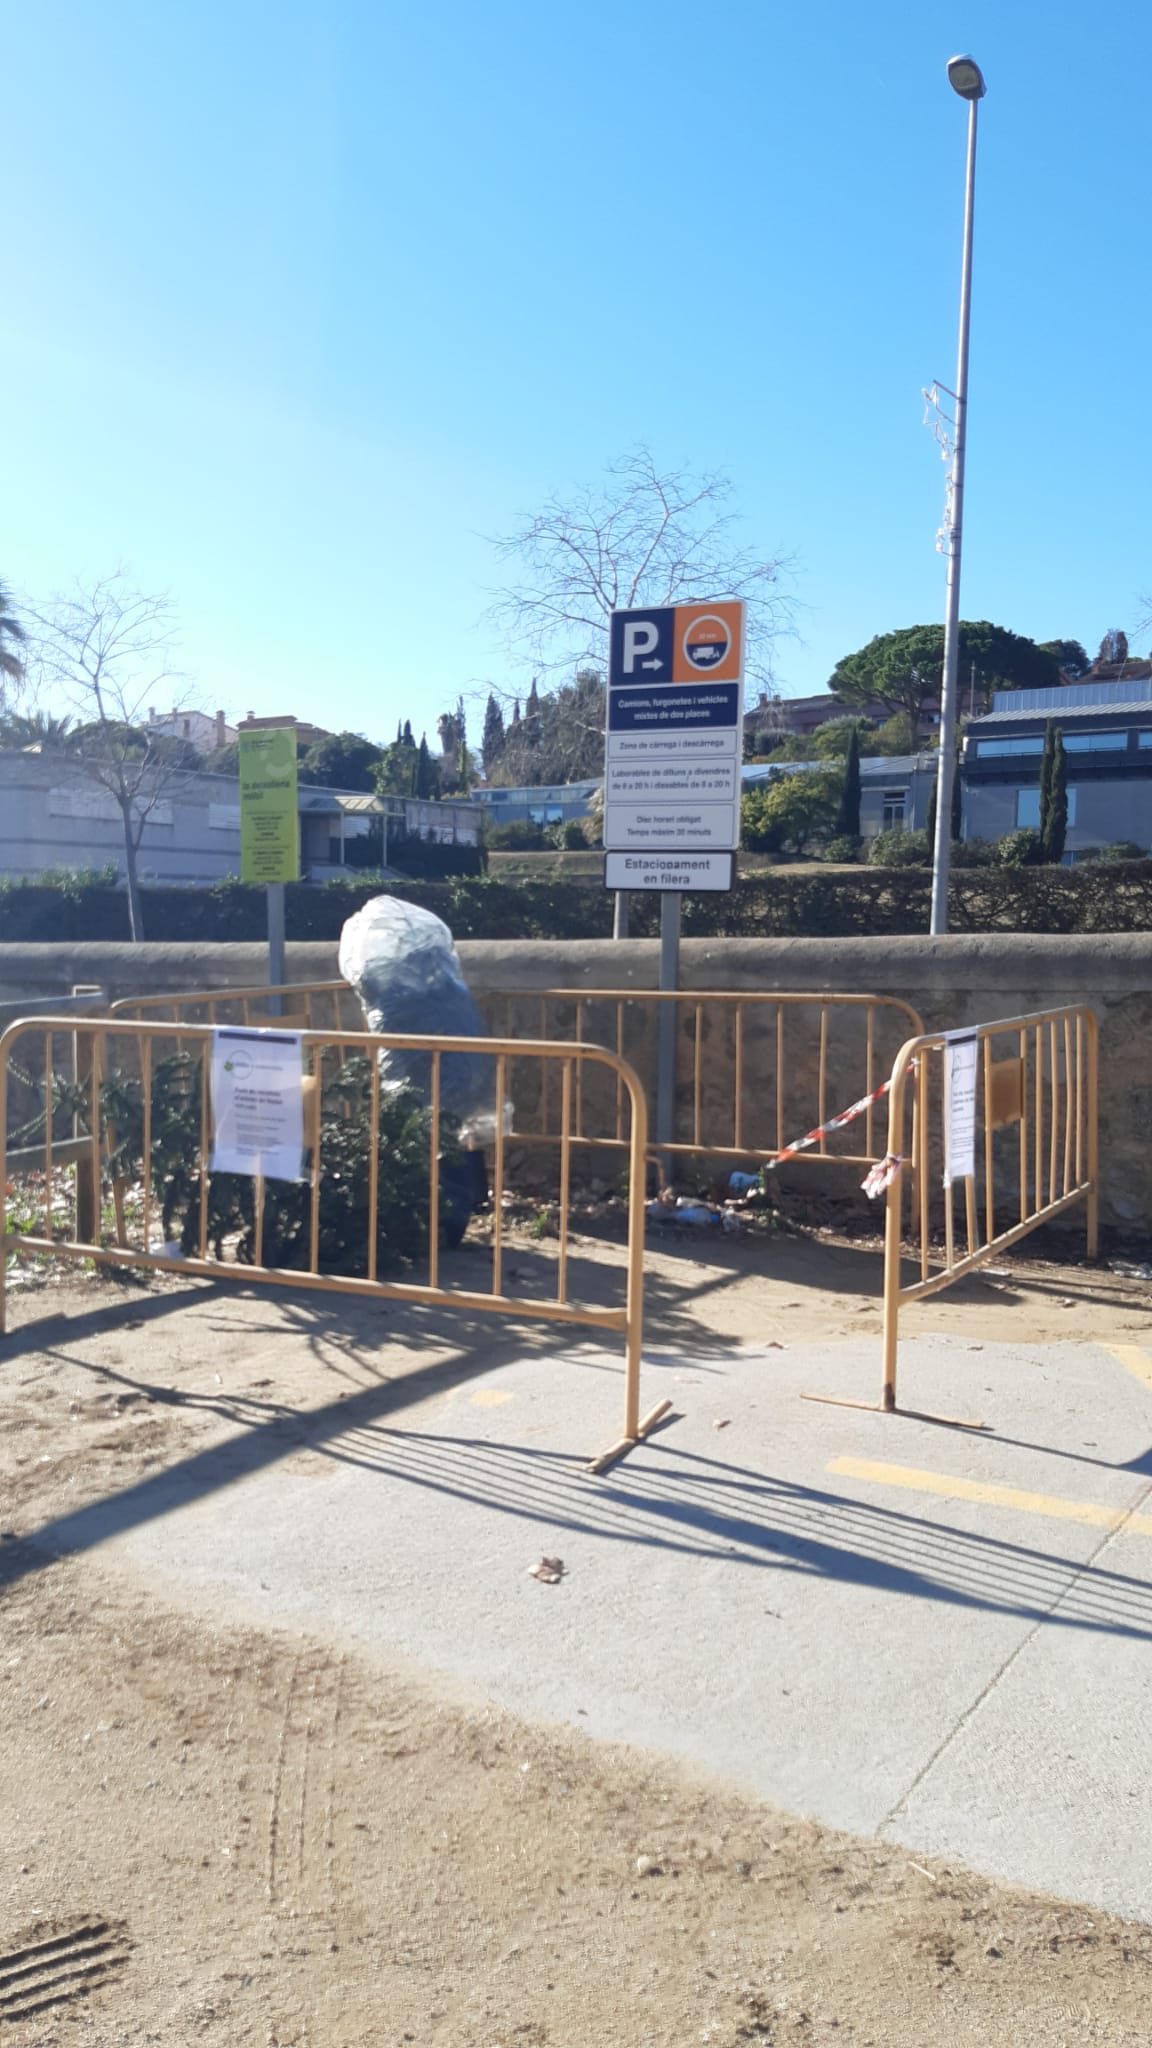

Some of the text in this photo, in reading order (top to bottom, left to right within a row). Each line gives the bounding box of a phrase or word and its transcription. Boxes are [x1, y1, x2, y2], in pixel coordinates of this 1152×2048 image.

[624, 621, 659, 674] P
[659, 711, 668, 719] de
[685, 710, 710, 720] places
[619, 742, 637, 750] Zona
[638, 741, 648, 749] de
[612, 782, 621, 790] de
[690, 781, 700, 789] de
[625, 858, 710, 870] Estacionament
[643, 874, 690, 885] en filera
